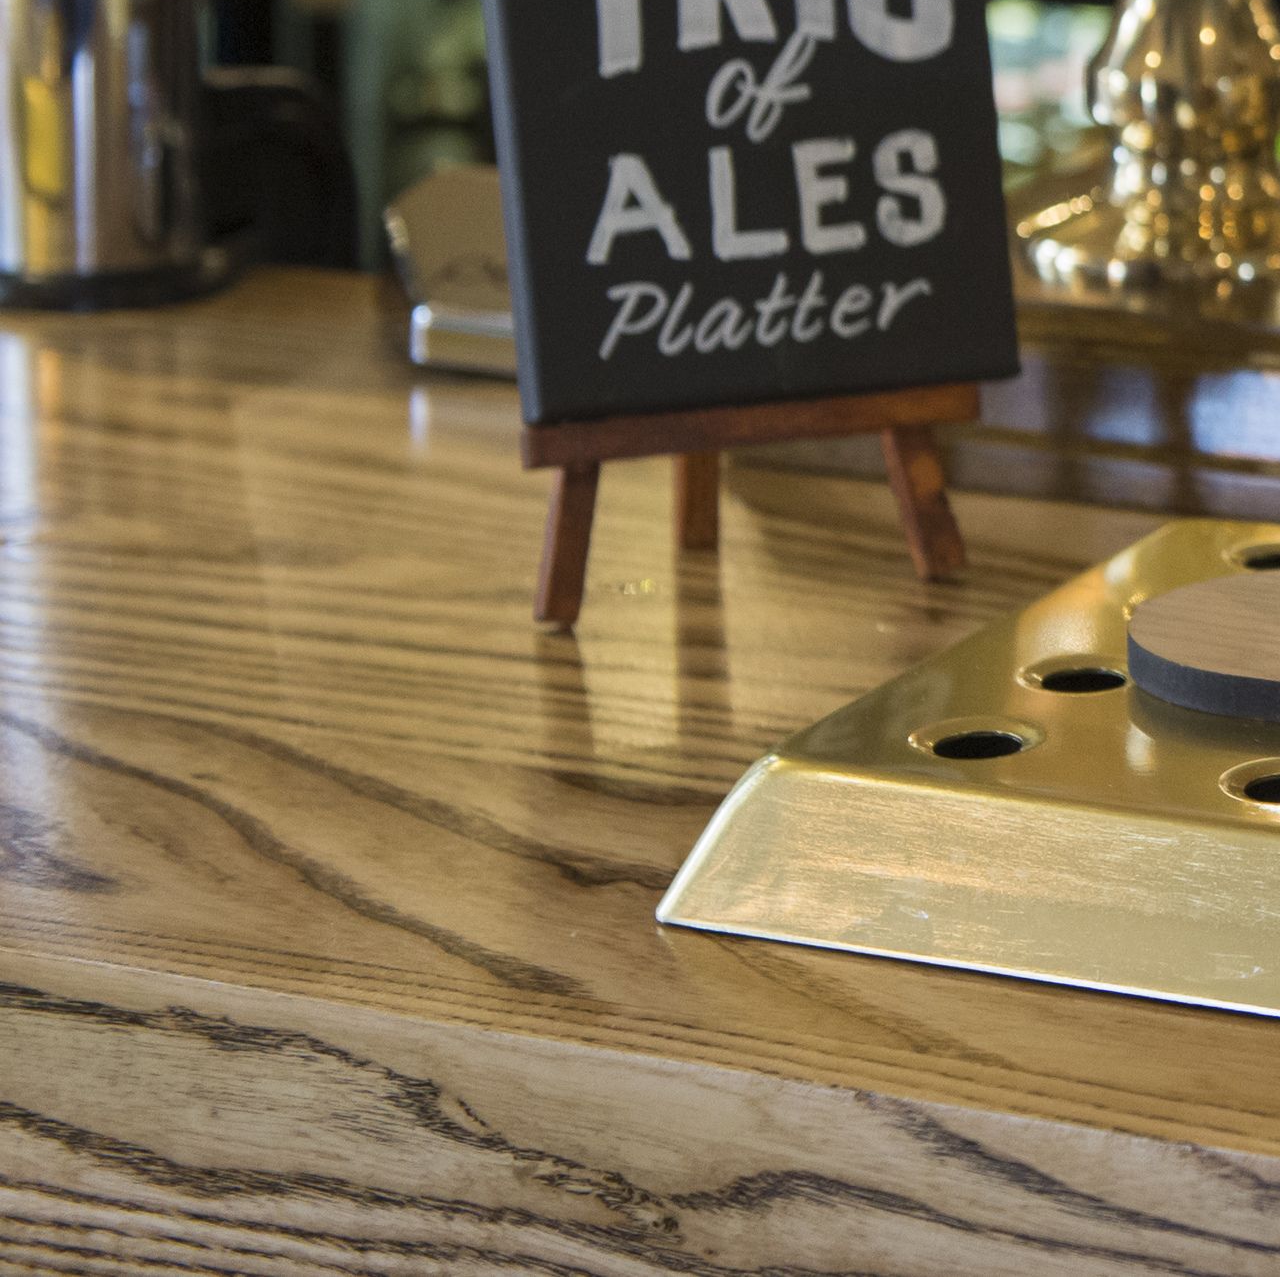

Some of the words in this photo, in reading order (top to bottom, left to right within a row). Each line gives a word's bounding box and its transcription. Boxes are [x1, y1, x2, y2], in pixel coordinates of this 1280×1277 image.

[706, 31, 810, 143] of
[587, 129, 946, 266] ALES
[599, 270, 931, 361] Platter
